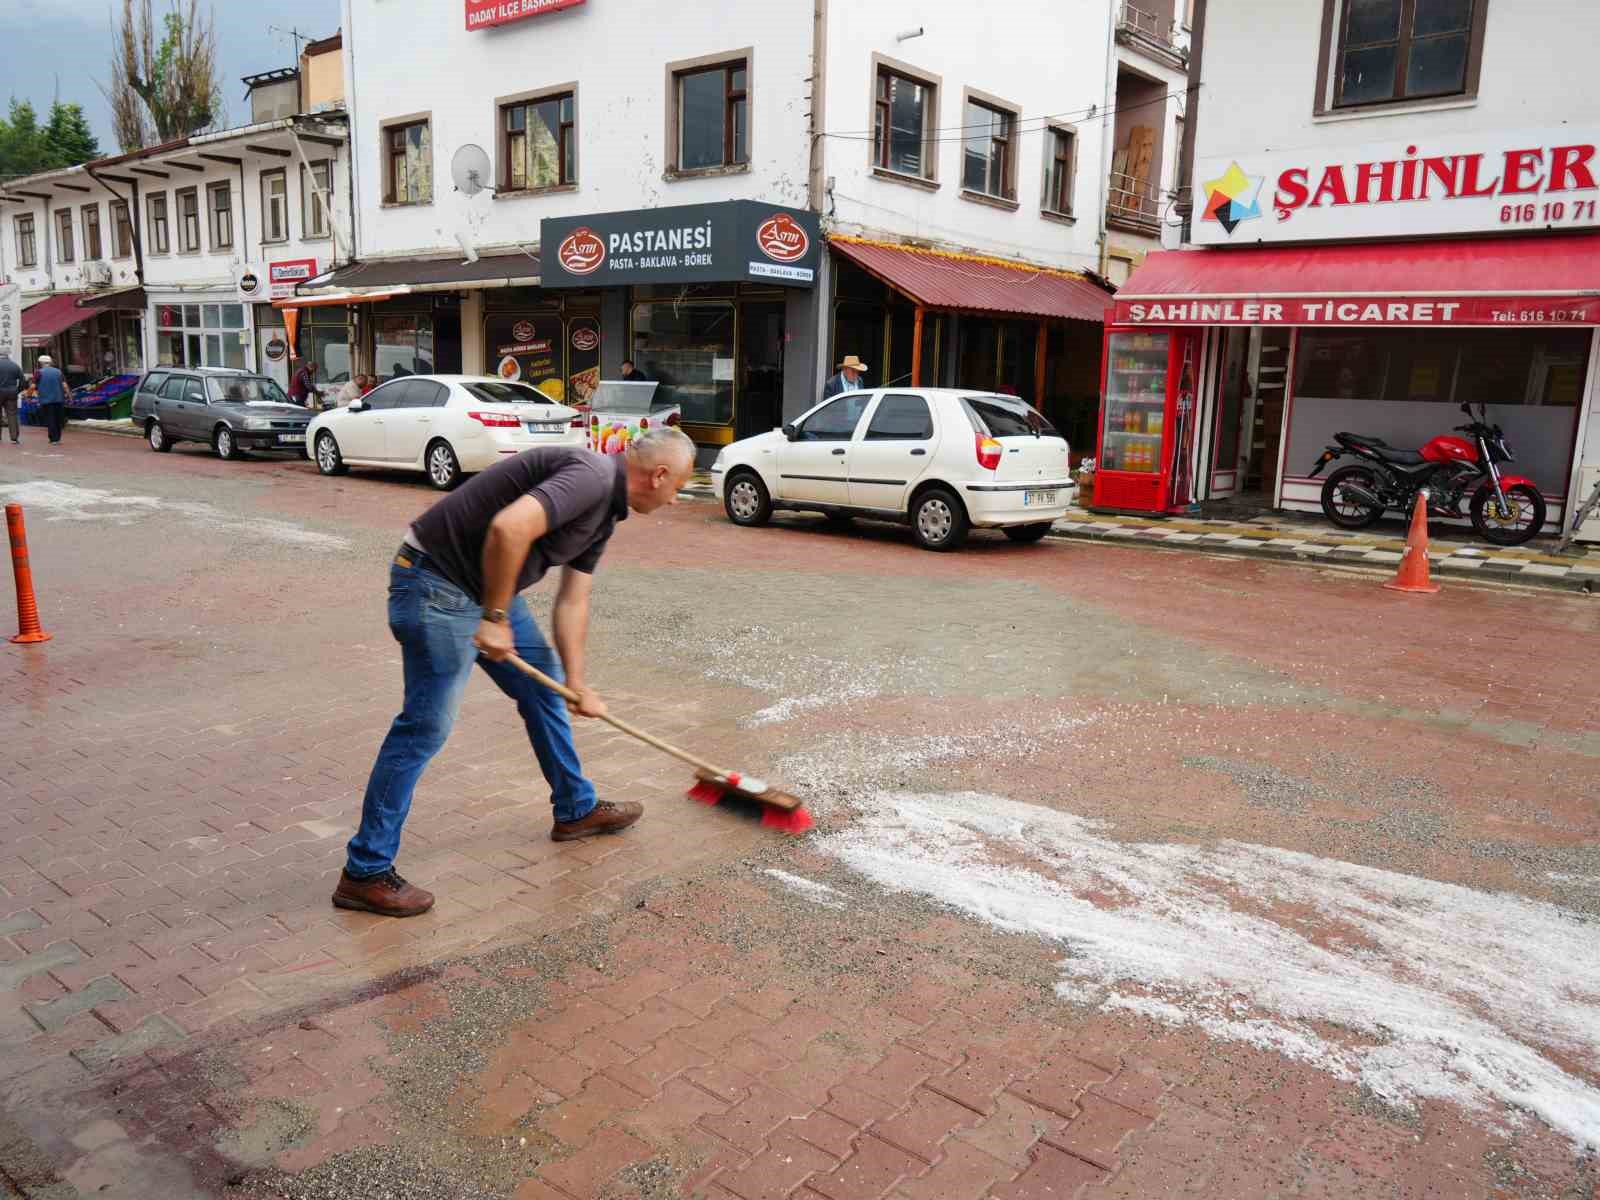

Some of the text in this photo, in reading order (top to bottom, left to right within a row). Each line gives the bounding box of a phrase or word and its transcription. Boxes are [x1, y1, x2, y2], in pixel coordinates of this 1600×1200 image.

[469, 7, 497, 25] DADAY
[1273, 144, 1599, 223] ŞAHİNLER
[1500, 200, 1595, 222] 616 10 71
[609, 220, 711, 253] PASTANESİ
[609, 257, 634, 270] PASTA
[640, 256, 678, 269] BAKLAVA
[685, 252, 712, 266] BÖREK
[1129, 301, 1587, 322] ŞAHİNLER TİCARET Tel: 616 10 71
